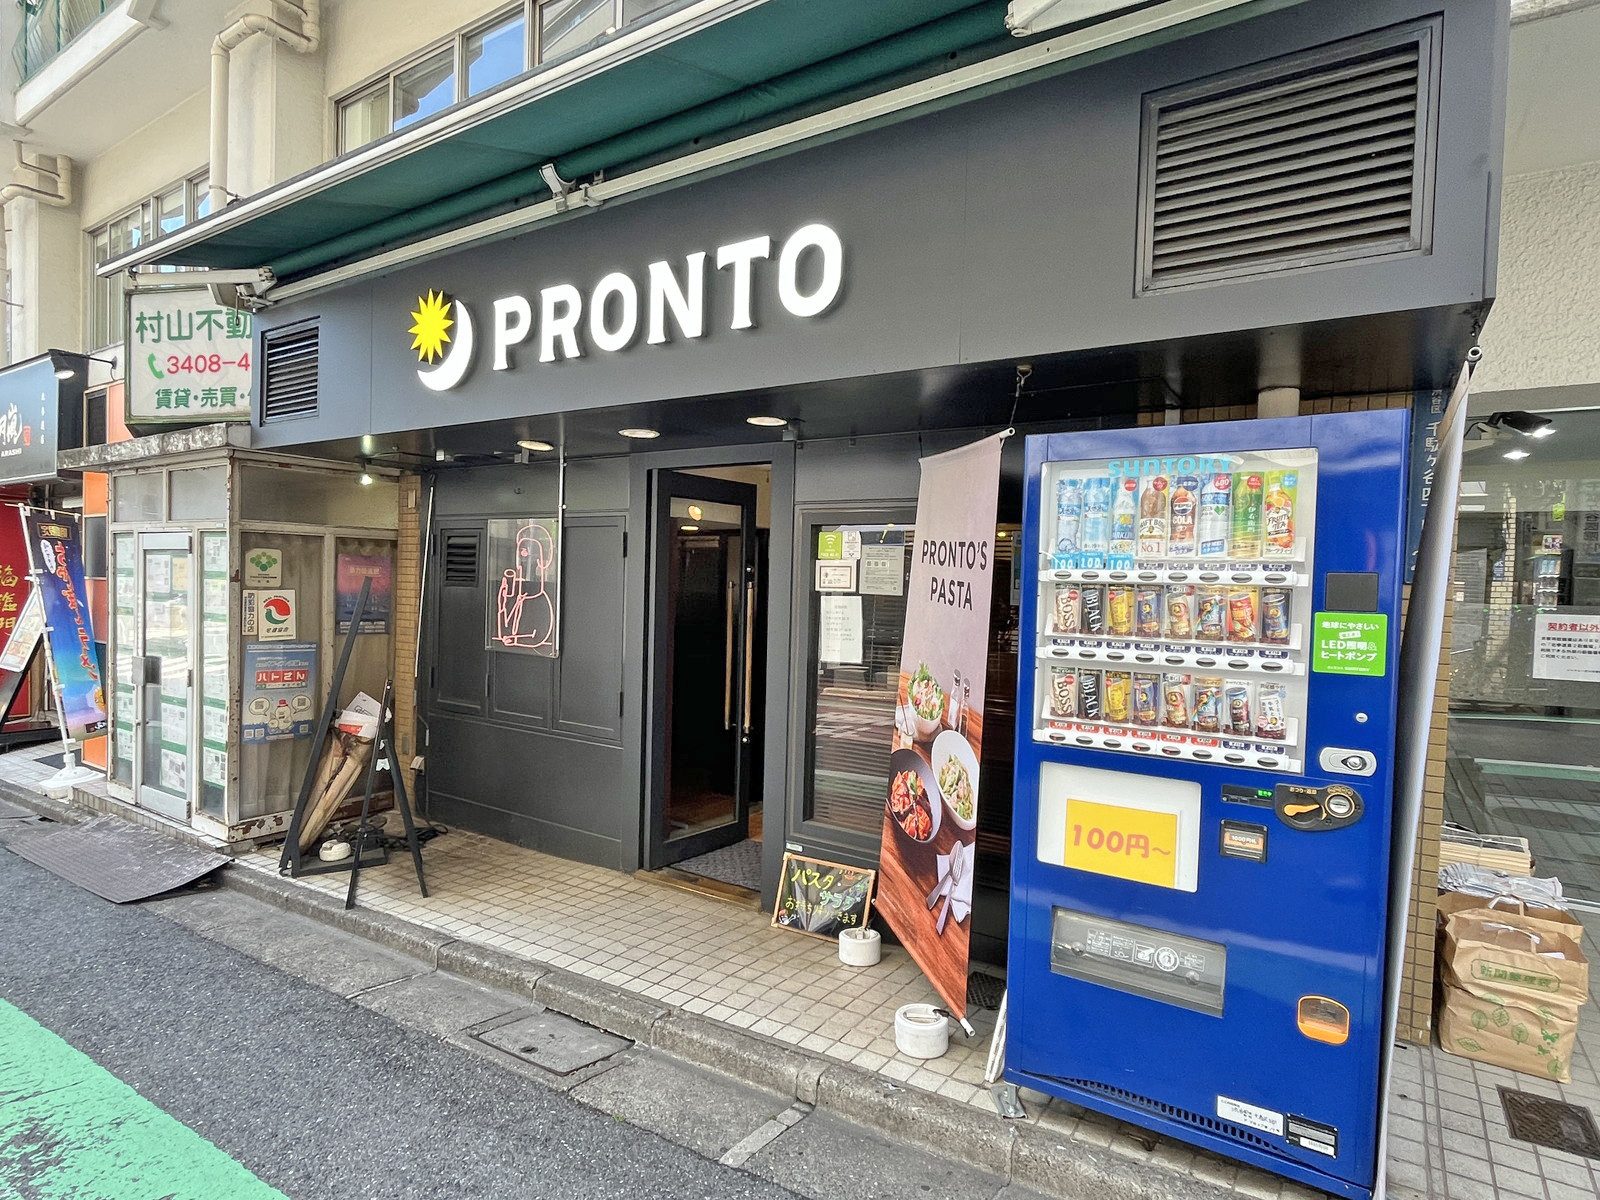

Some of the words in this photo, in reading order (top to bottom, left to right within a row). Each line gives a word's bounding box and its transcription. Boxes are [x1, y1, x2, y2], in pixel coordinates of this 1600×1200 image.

[492, 222, 843, 372] PRONTO
[1172, 515, 1193, 525] COLA
[921, 540, 989, 571] PRONTO'S
[1081, 557, 1101, 568] 100
[930, 576, 973, 611] PASTA
[1061, 593, 1076, 629] BOSS
[1085, 591, 1103, 632] BLACK
[1321, 621, 1380, 631] 地球にやさしい
[1321, 651, 1378, 662] ヒートポンプ
[1057, 682, 1073, 715] BOSS
[1081, 680, 1101, 718] BLACK
[791, 868, 835, 890] パスタ
[819, 890, 861, 911] サラダ
